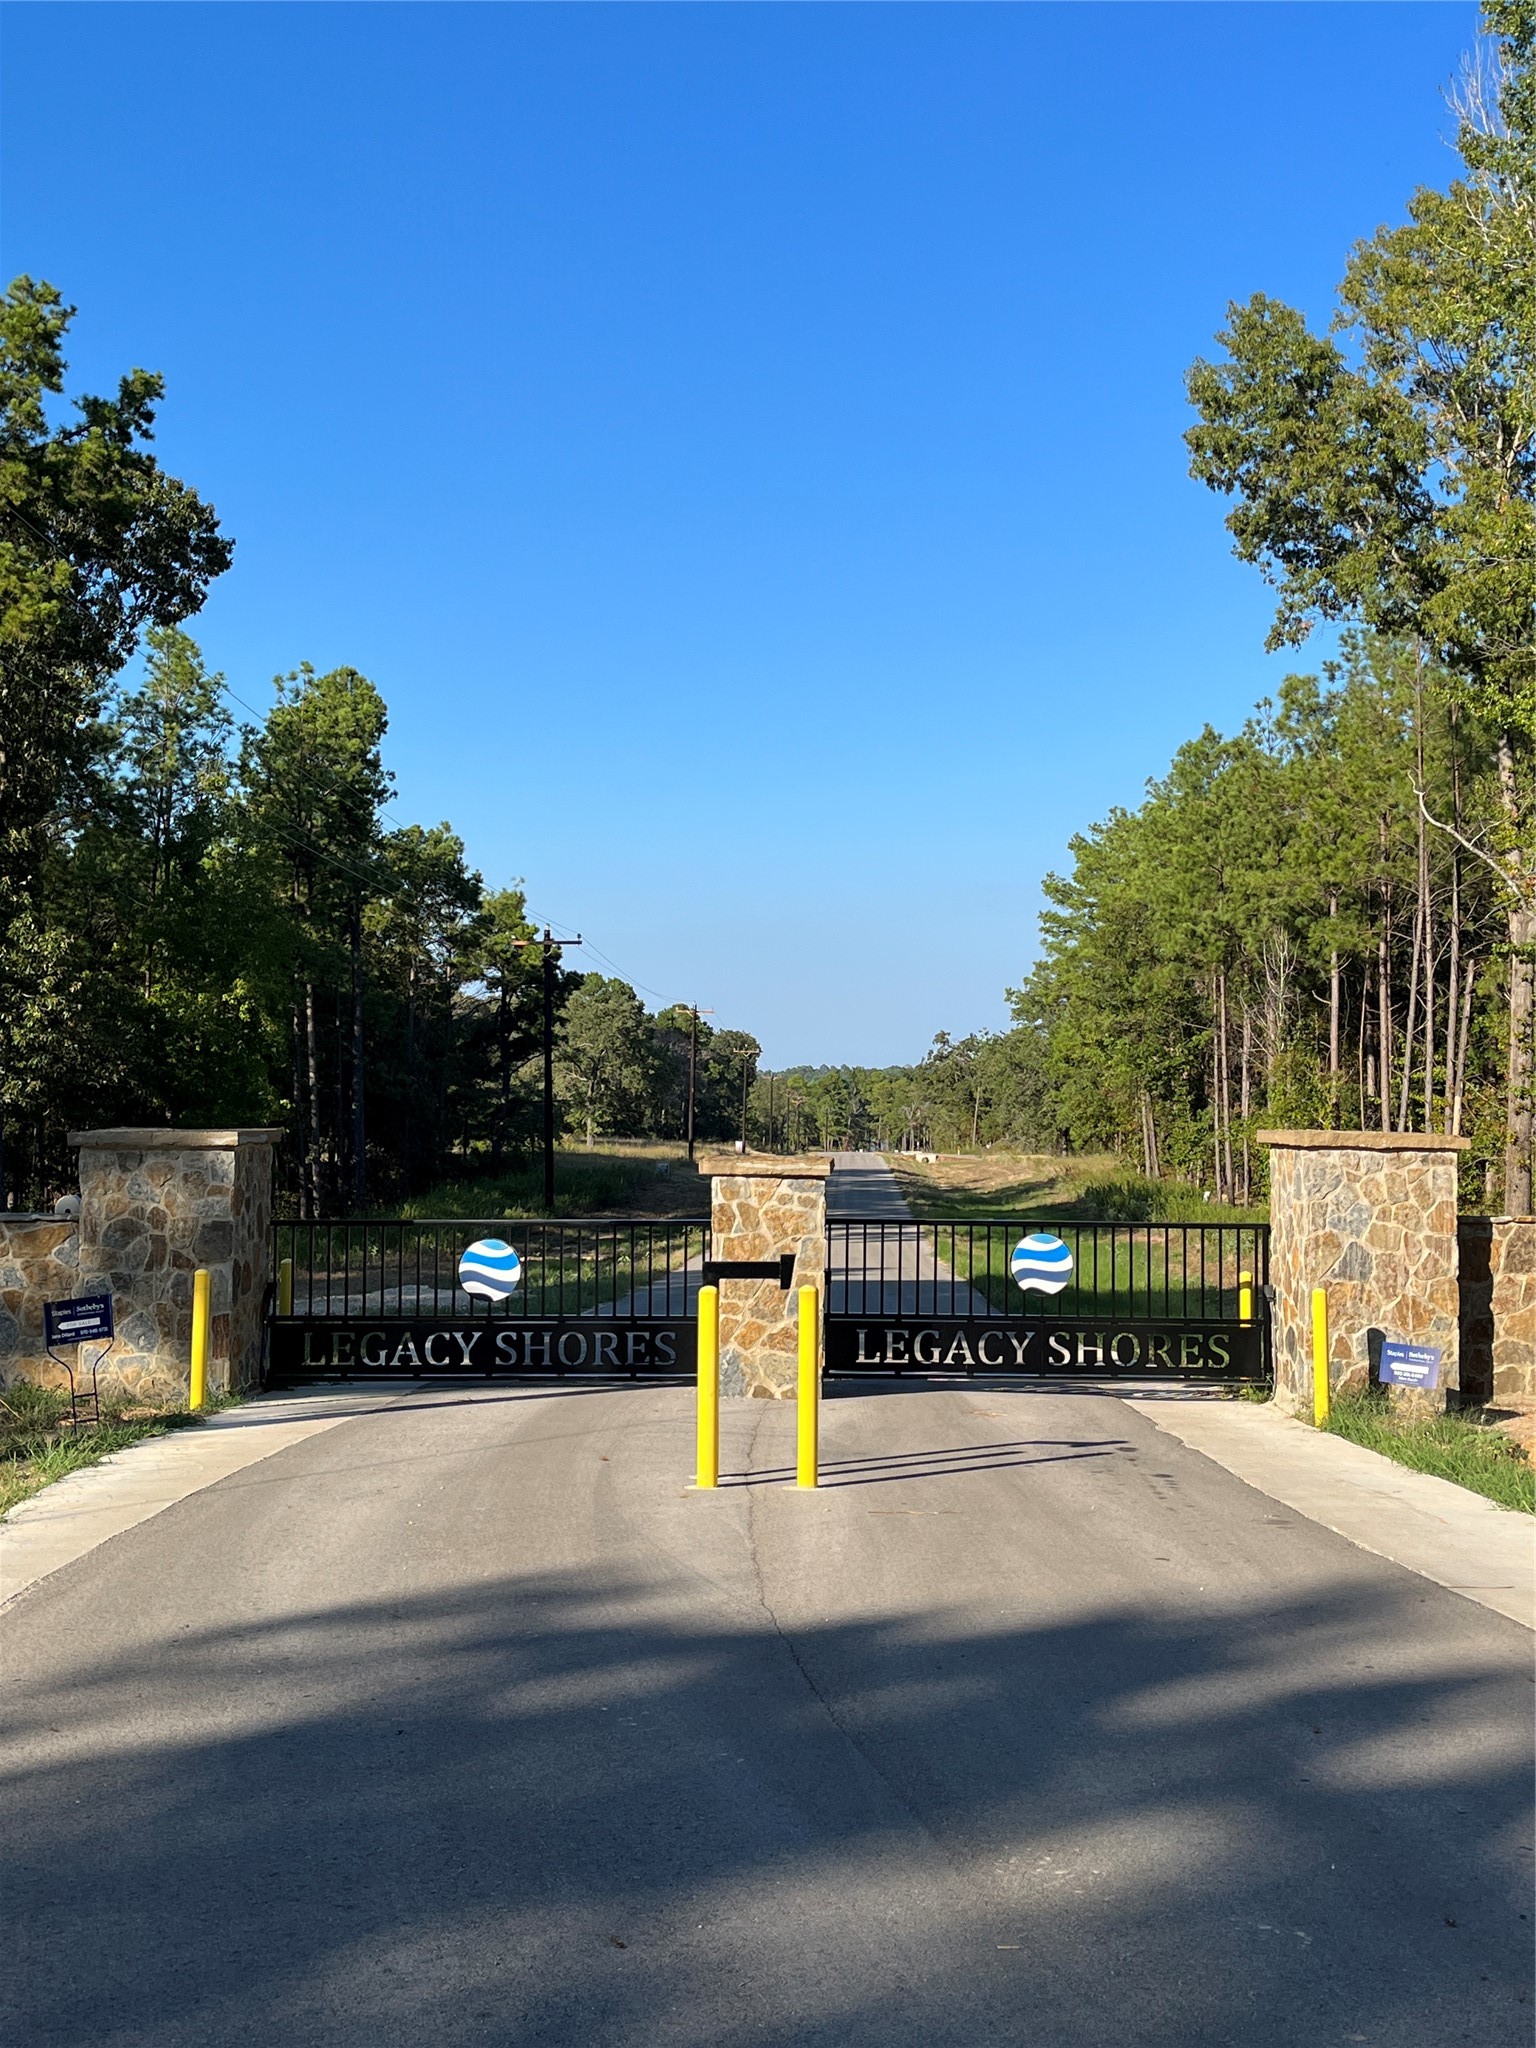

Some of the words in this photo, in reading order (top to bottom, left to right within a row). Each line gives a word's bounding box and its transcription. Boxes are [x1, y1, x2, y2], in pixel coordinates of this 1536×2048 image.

[76, 1303, 104, 1312] Sotheby's
[302, 1331, 483, 1366] LEGACY
[495, 1331, 678, 1366] SHORES
[855, 1328, 1036, 1365] LEGACY
[1048, 1331, 1230, 1368] SHORES
[1408, 1351, 1434, 1360] Sotheby's
